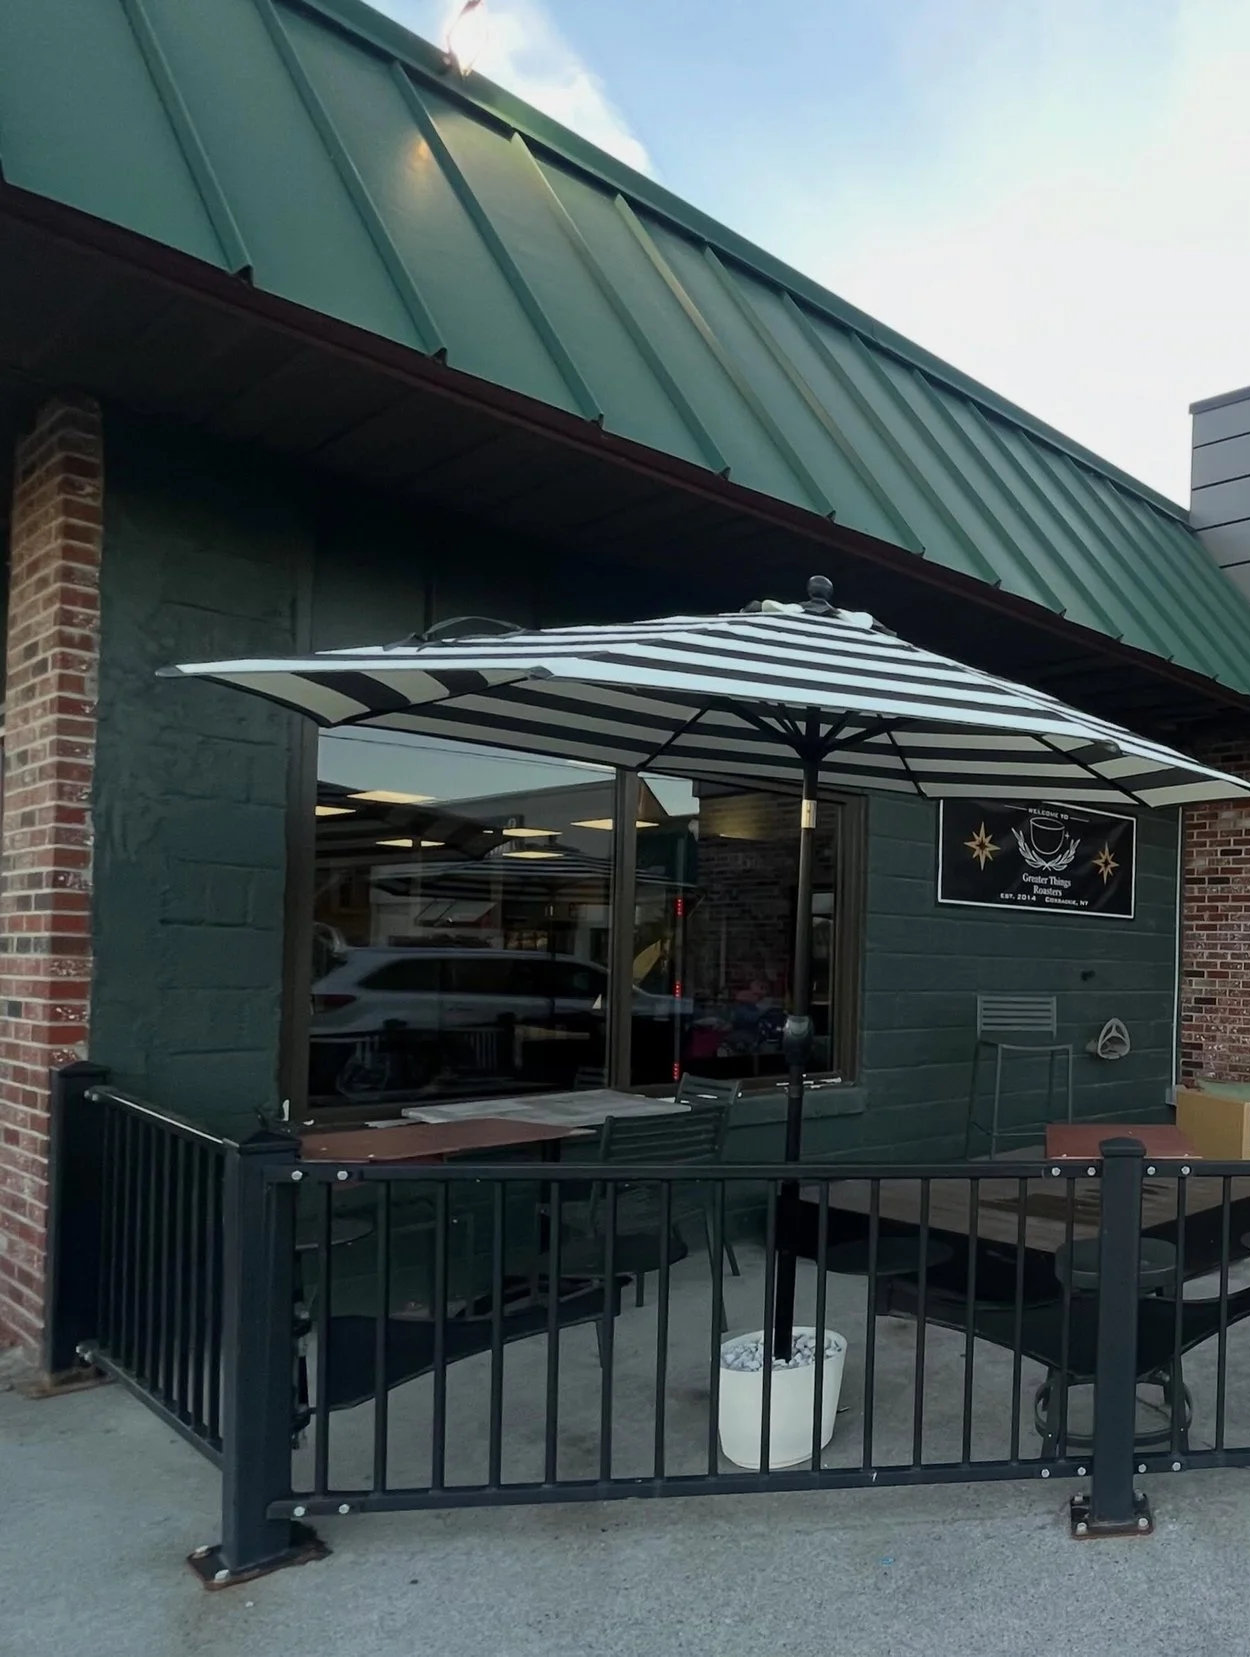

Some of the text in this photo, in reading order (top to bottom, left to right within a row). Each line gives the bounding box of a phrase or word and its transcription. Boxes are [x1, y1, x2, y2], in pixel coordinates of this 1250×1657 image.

[1028, 808, 1059, 818] WELCOME
[1022, 873, 1071, 888] Greater Things
[1033, 885, 1062, 896] Roasters
[1000, 892, 1037, 901] EST. 2014
